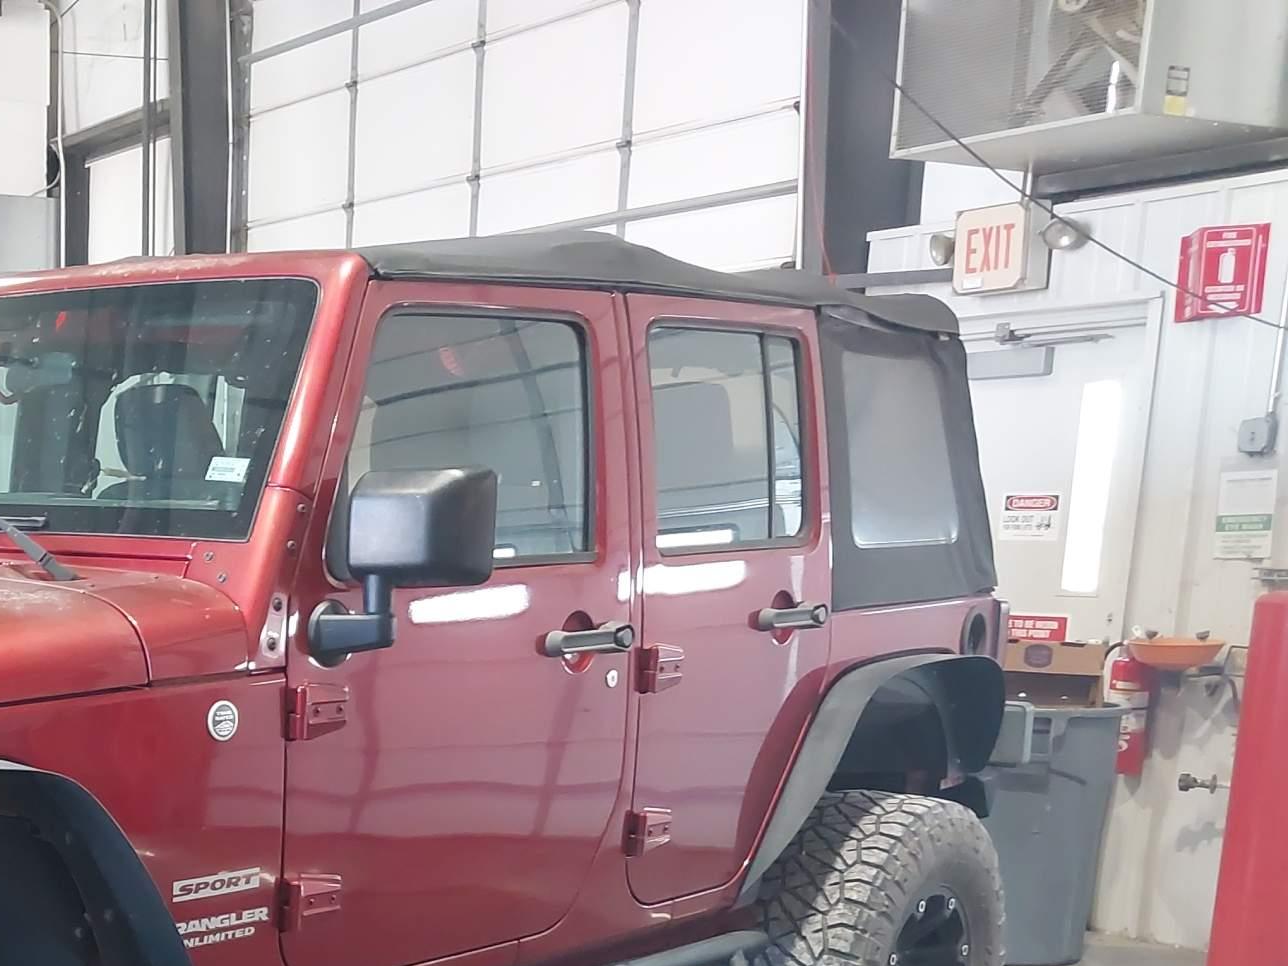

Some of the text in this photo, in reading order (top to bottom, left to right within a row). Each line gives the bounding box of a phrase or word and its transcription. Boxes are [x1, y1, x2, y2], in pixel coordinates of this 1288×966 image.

[965, 223, 1015, 274] EXIT
[1011, 498, 1052, 508] DANGER
[175, 873, 259, 896] SPORT
[175, 906, 269, 936] RANGLER
[182, 926, 256, 949] NLIMITED
